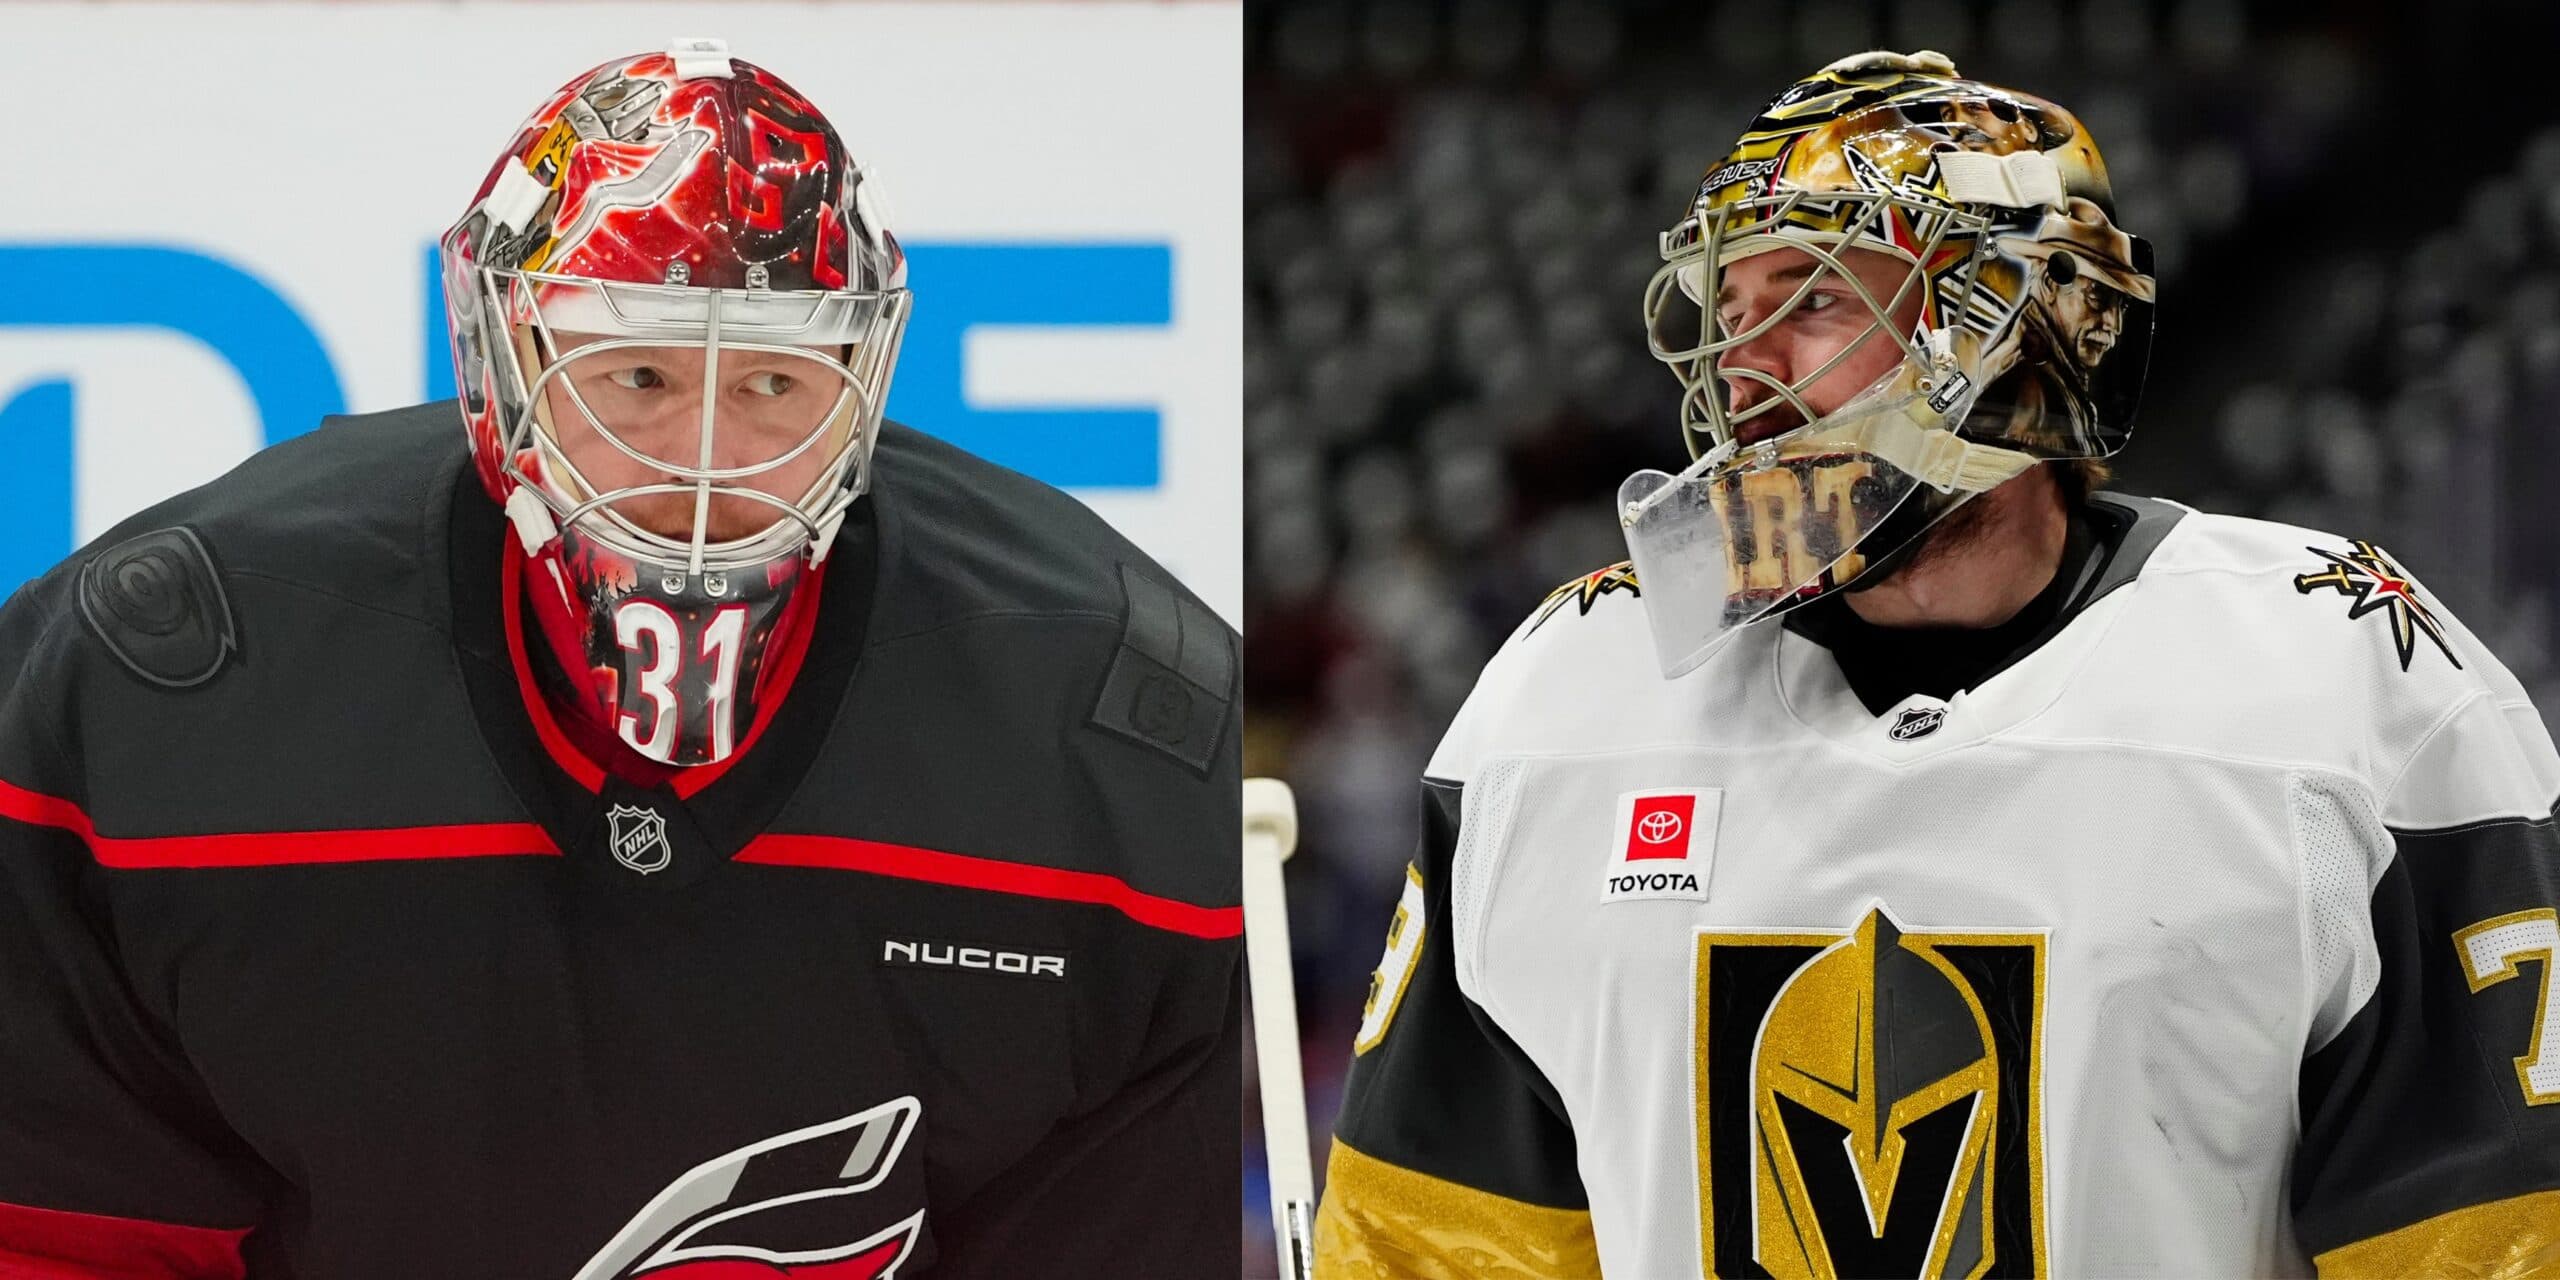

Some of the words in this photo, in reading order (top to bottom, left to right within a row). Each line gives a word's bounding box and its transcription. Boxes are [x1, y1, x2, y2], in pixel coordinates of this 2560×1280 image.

[615, 598, 749, 764] 31
[1899, 716, 1939, 738] NHL
[624, 824, 656, 857] NHL
[1609, 873, 1699, 894] TOYOTA
[884, 940, 1065, 977] NUCOR
[2451, 907, 2560, 1107] 7
